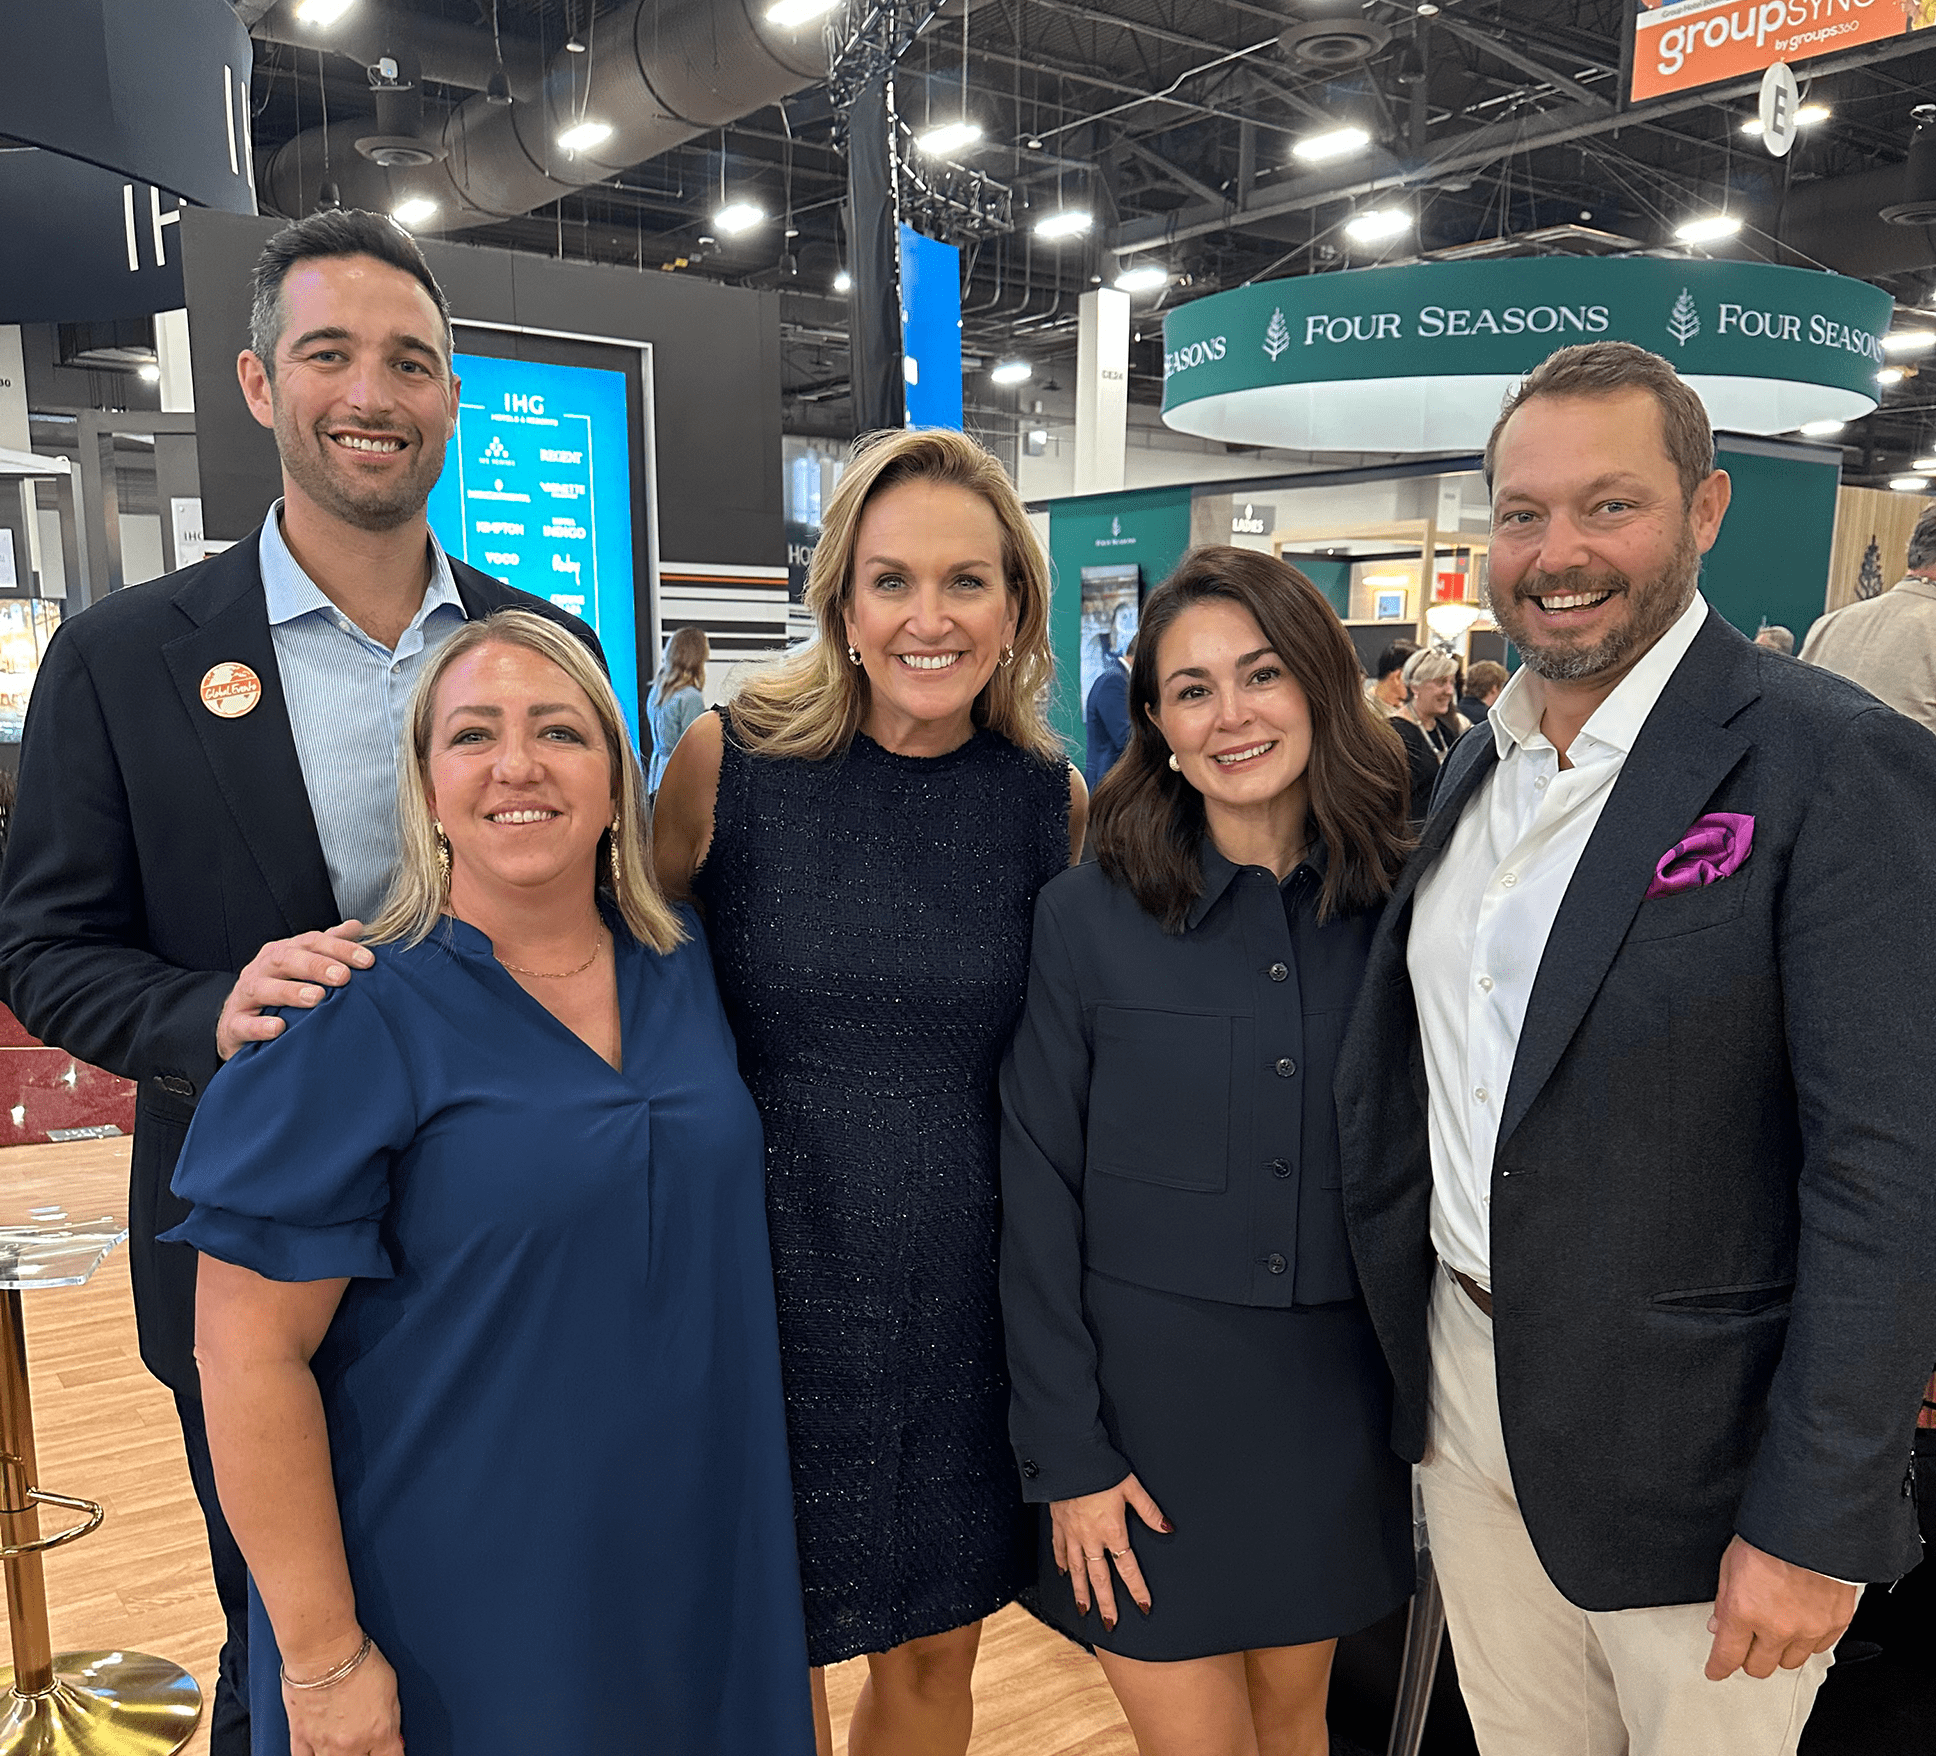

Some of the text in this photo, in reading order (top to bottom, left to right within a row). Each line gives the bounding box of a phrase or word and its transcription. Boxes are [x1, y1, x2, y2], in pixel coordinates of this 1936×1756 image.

[1775, 20, 1860, 52] by groups360
[1772, 84, 1789, 137] E
[1303, 305, 1609, 346] FOUR SEASONS
[1717, 303, 1801, 342] FOUR
[504, 392, 545, 415] IHG
